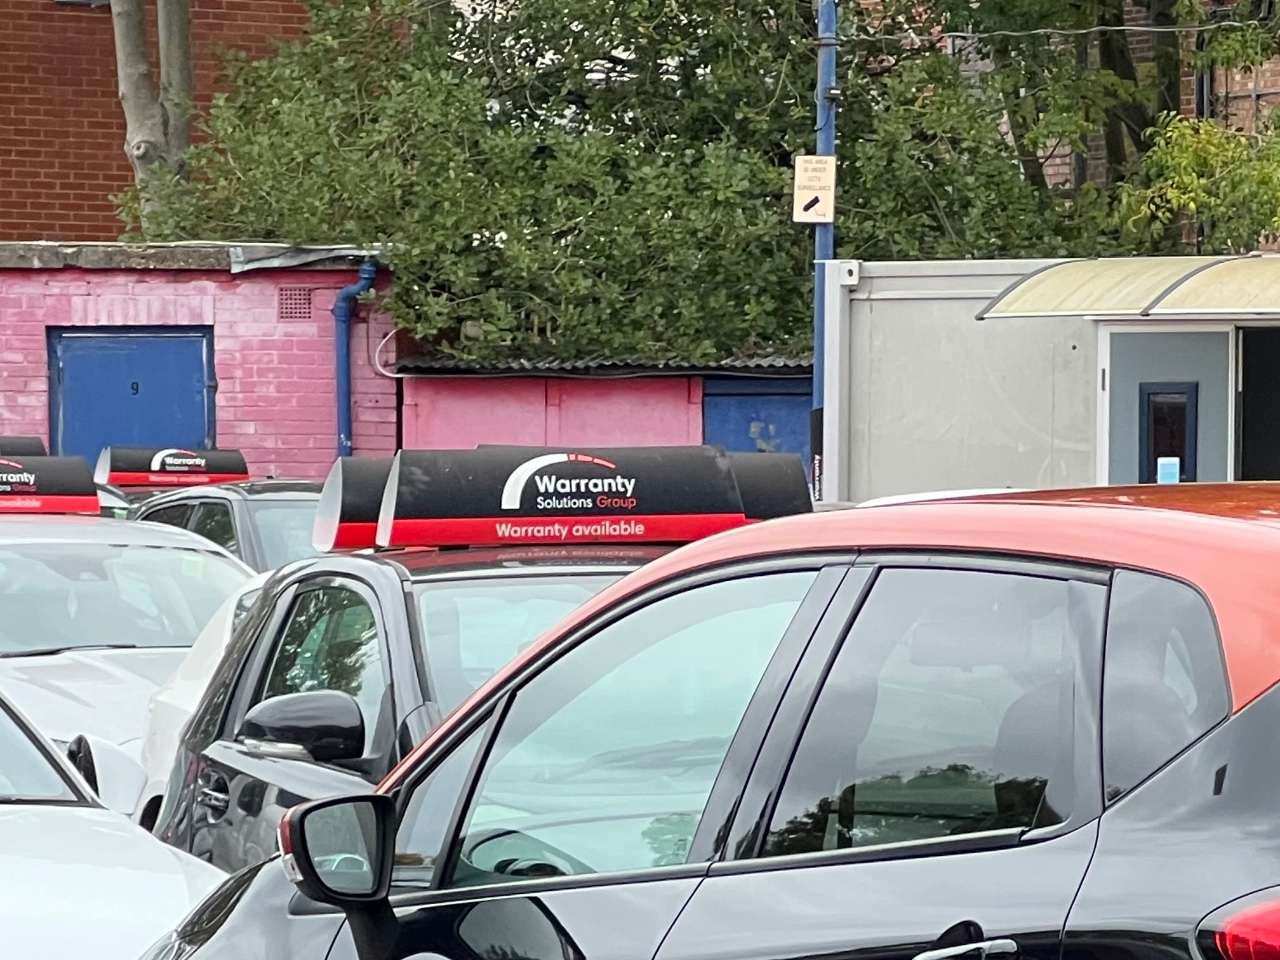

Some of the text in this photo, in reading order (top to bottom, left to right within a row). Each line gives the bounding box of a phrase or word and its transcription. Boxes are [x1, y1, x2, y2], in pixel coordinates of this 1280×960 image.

[131, 381, 139, 396] 9
[534, 475, 636, 497] Warranty
[537, 496, 637, 510] Solutions Group
[495, 520, 645, 540] Warranty available
